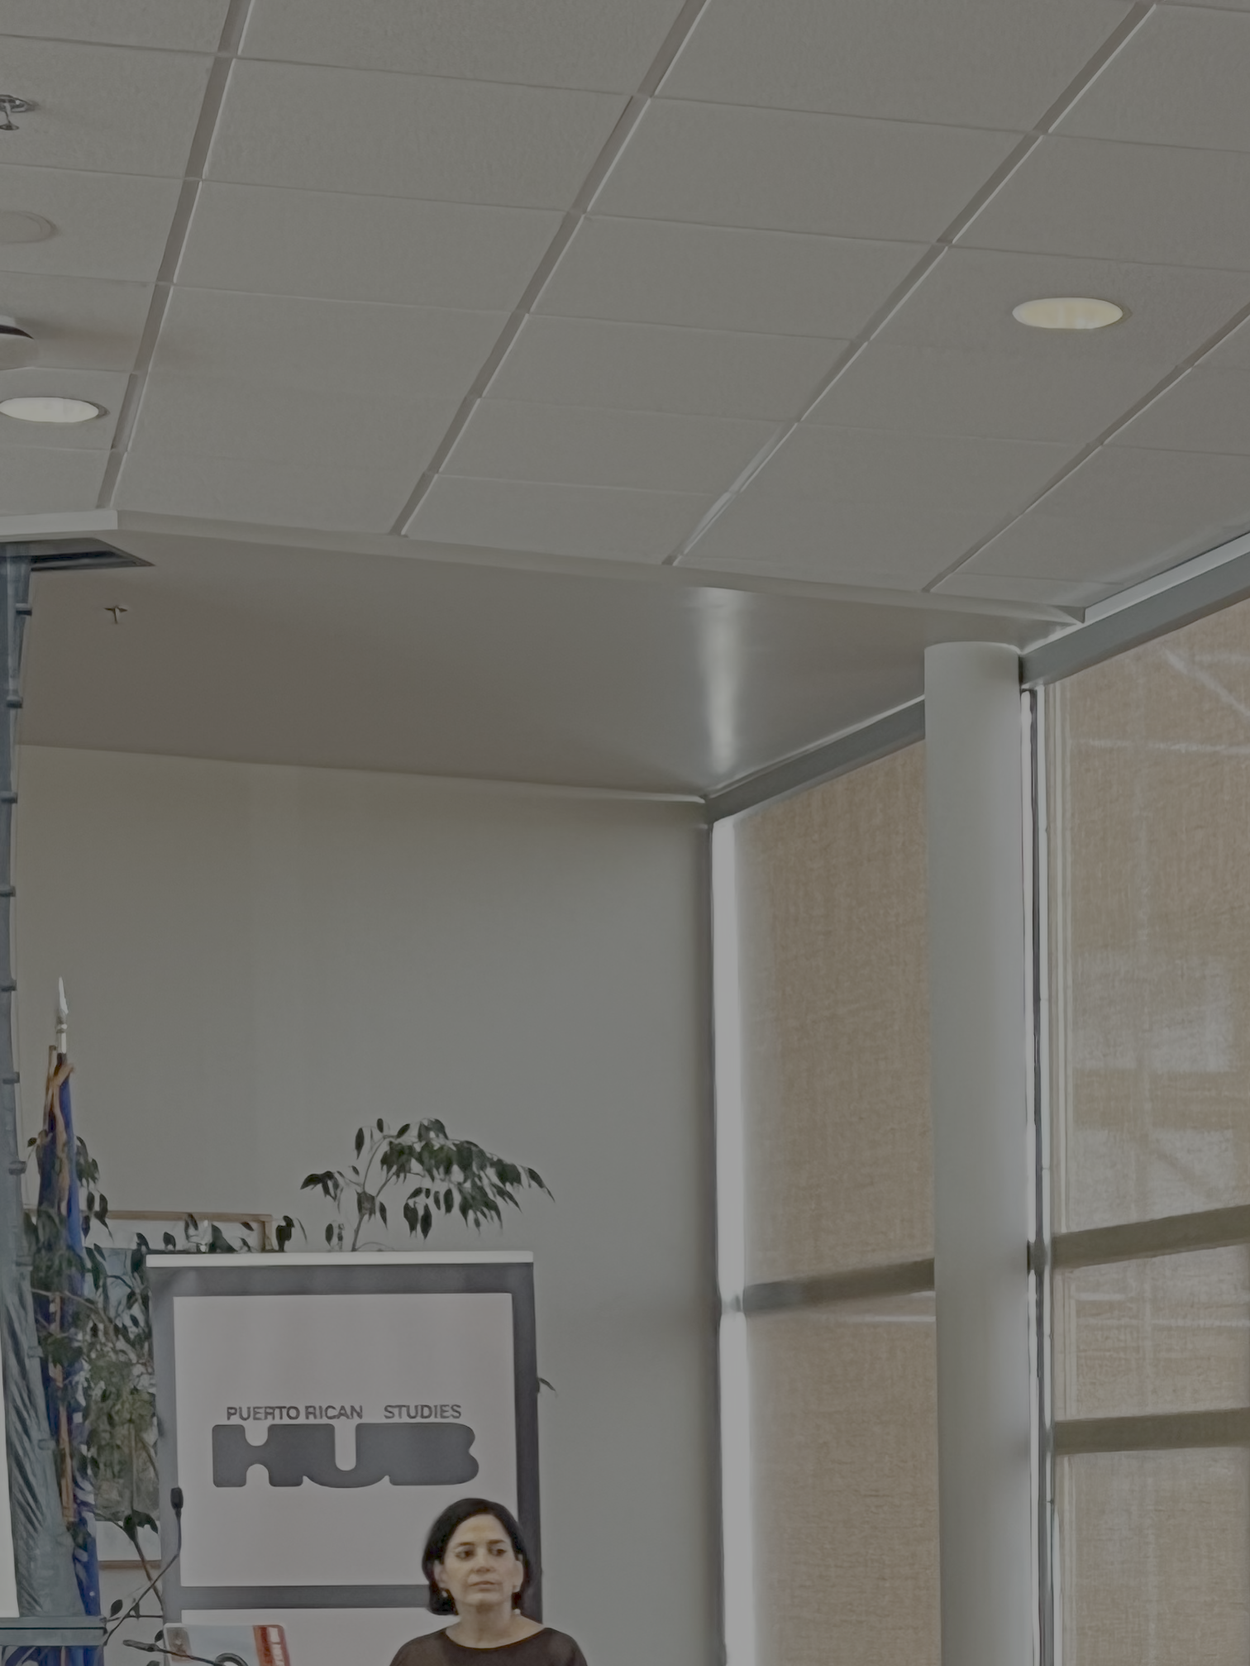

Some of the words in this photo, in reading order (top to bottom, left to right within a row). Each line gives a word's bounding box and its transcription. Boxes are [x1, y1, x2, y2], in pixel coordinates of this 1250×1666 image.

[227, 1406, 300, 1421] PUERTO
[305, 1405, 363, 1420] RICAN
[384, 1404, 462, 1419] STUDIES
[212, 1423, 480, 1489] HUB
